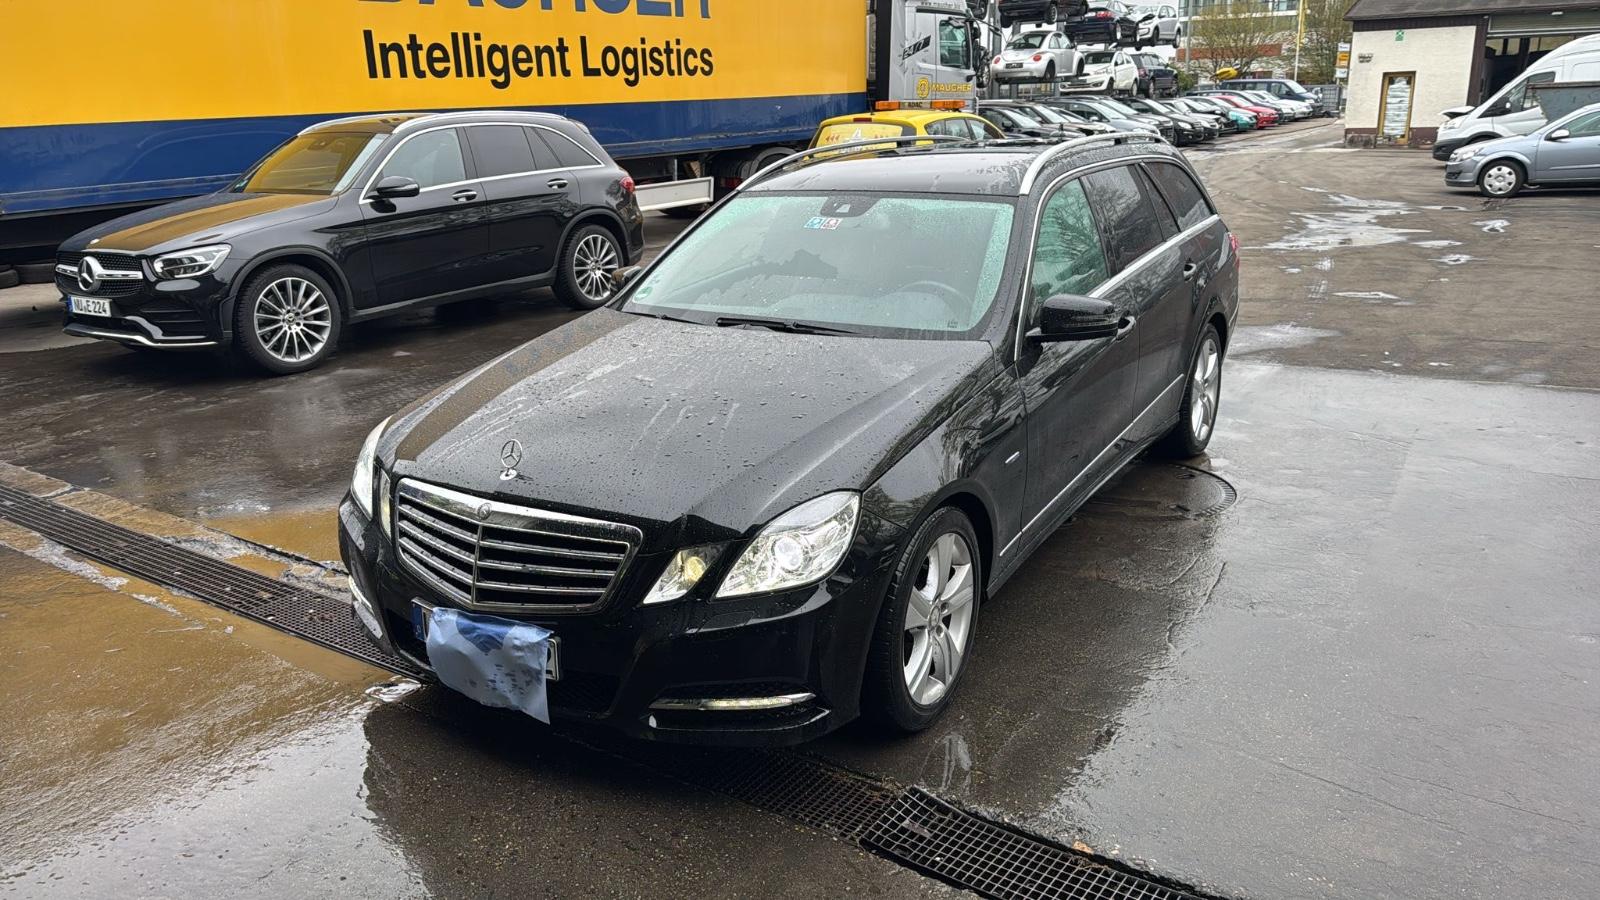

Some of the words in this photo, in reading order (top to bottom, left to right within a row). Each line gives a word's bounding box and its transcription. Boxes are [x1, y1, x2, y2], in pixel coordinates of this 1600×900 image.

[363, 29, 571, 89] Intelligent
[580, 36, 714, 87] Logistics
[92, 301, 107, 314] 224
